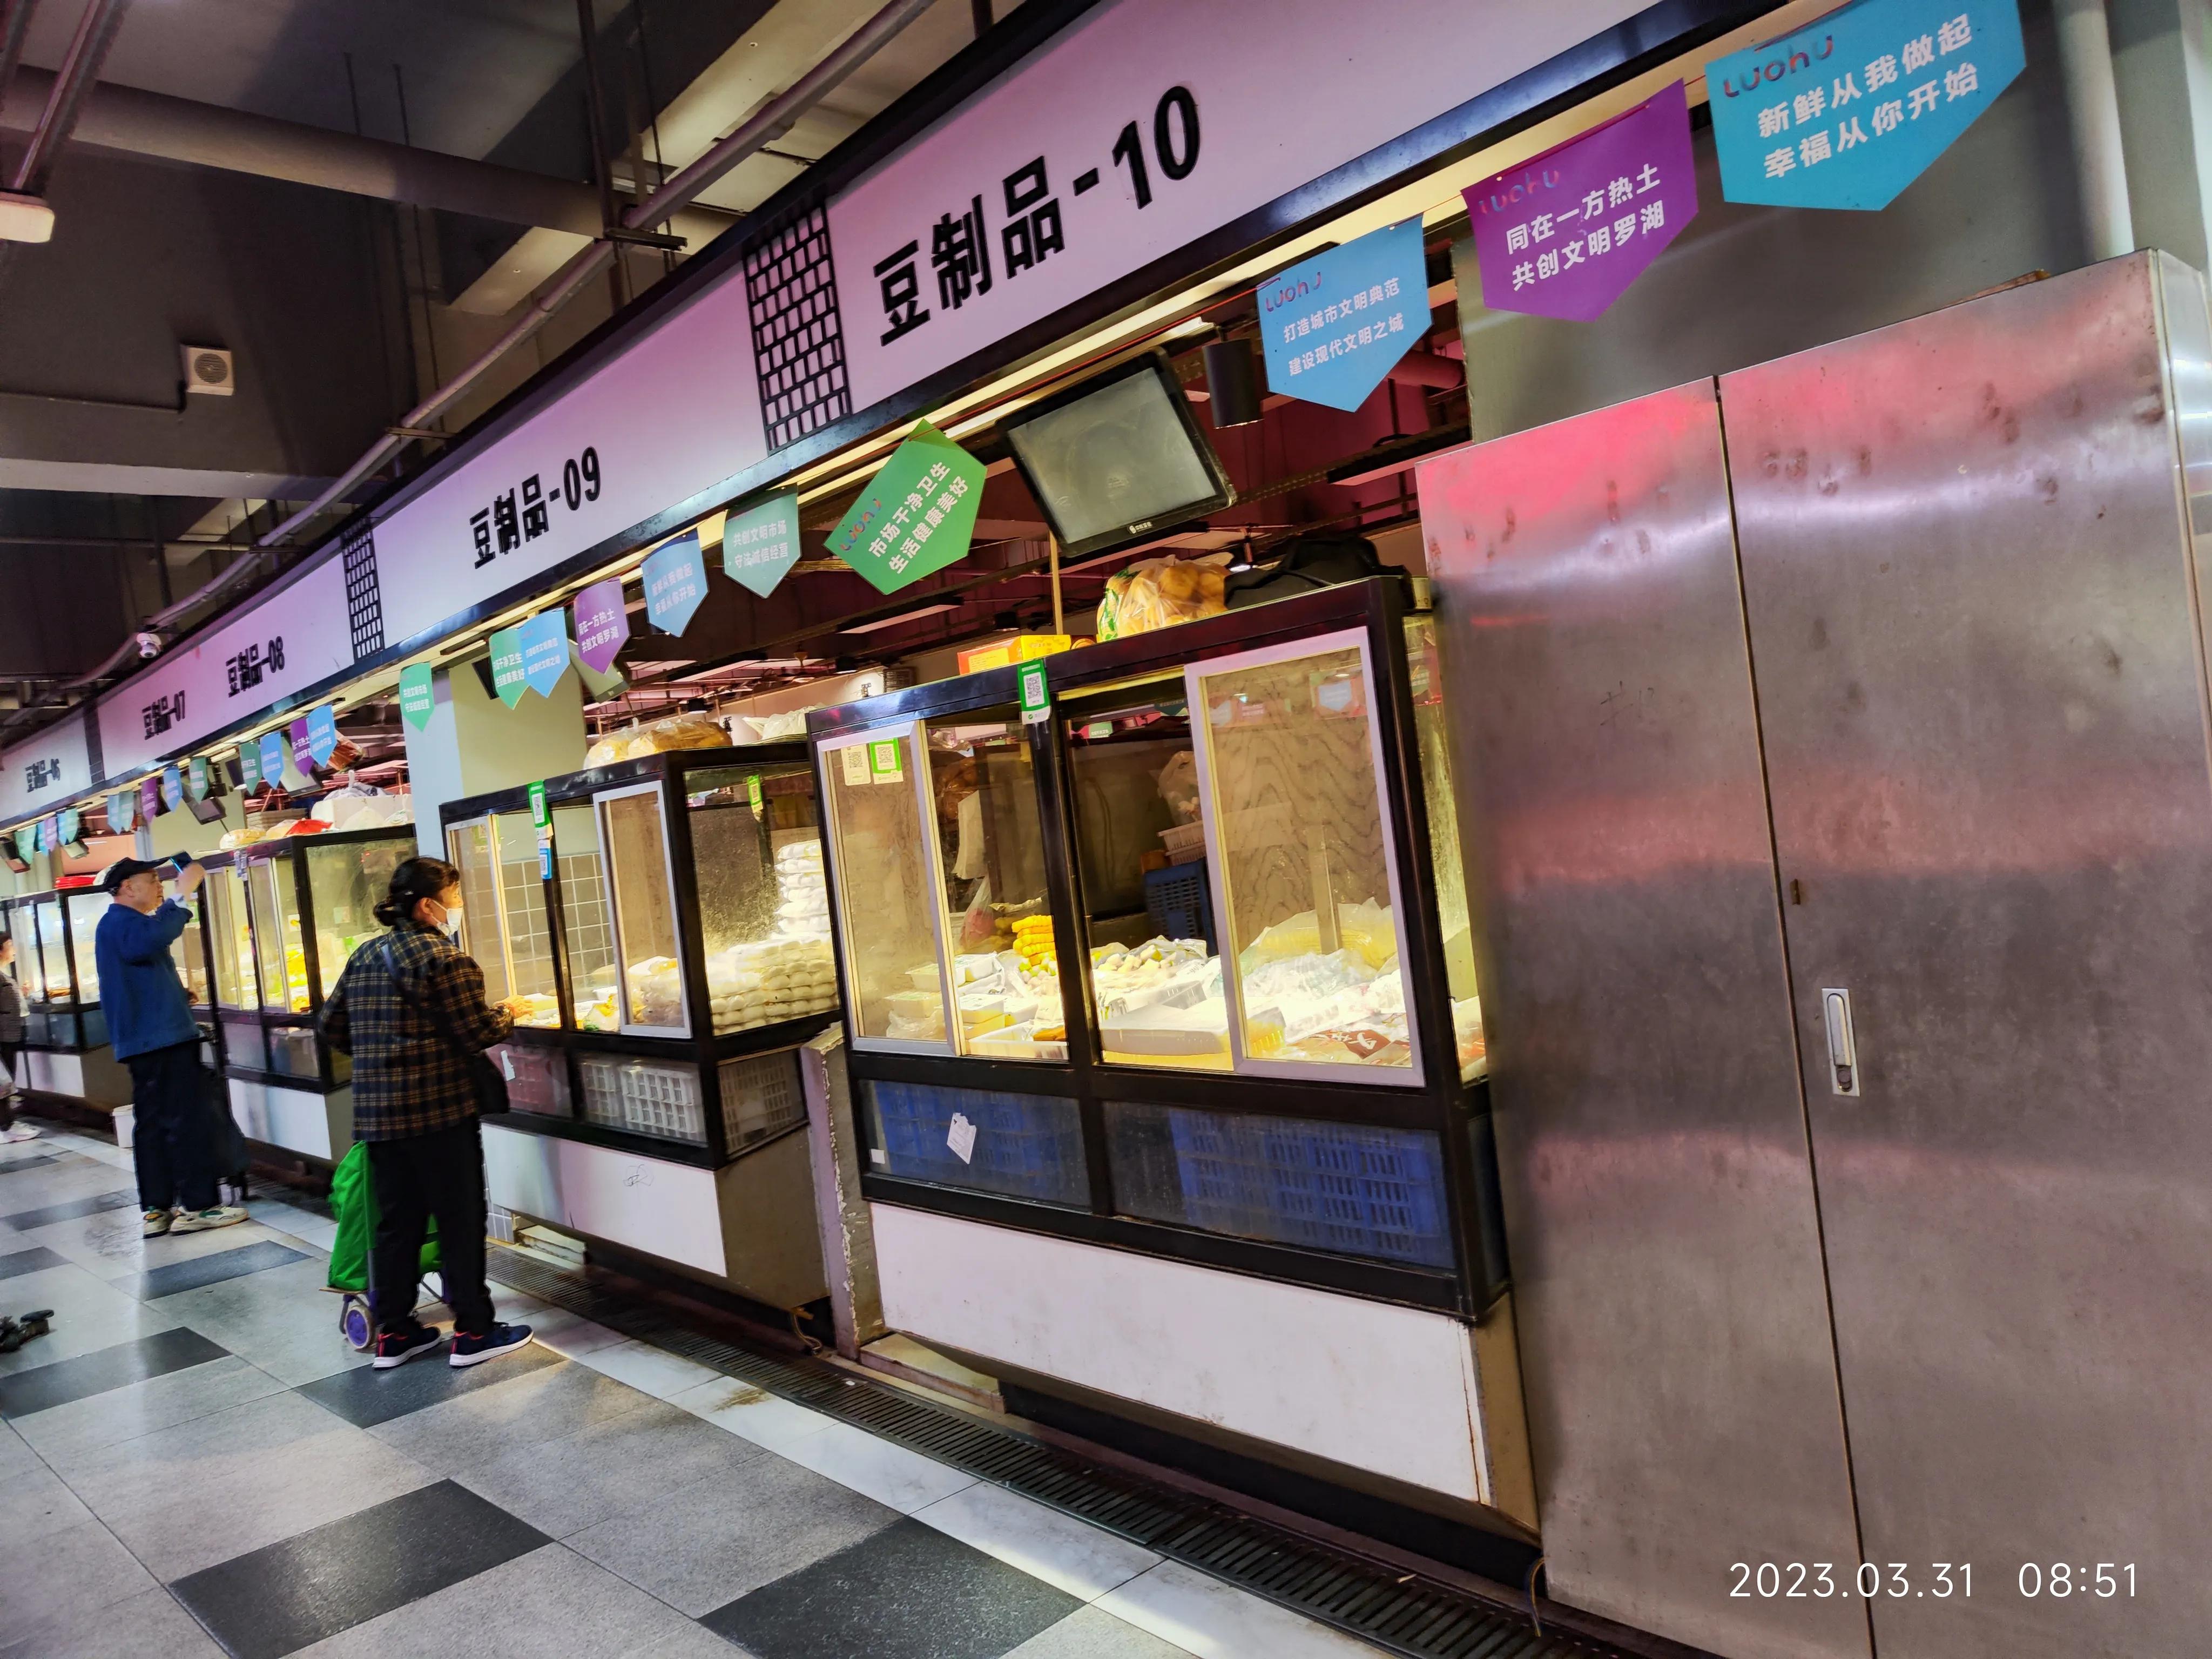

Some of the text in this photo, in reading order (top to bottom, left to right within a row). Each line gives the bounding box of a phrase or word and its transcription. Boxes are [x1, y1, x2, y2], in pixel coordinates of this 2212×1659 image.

[1758, 14, 1973, 138] 新鲜从我做起
[1763, 62, 1979, 178] 幸福从你开始
[873, 85, 1201, 347] 豆制品-10
[1506, 163, 1661, 254] 同在一方热土
[1512, 199, 1665, 292] 共创文明罗湖
[1283, 277, 1400, 344] 打造城市文明典范
[1288, 312, 1404, 376] 建设现代文明之城
[469, 446, 601, 569] 豆制品-09
[733, 520, 787, 547] 共创文明市场
[868, 462, 950, 557] 市场干净卫生
[888, 476, 968, 574] 生活健康美好
[734, 542, 788, 568] 守法诚信经营
[225, 636, 285, 698] 豆制品-08
